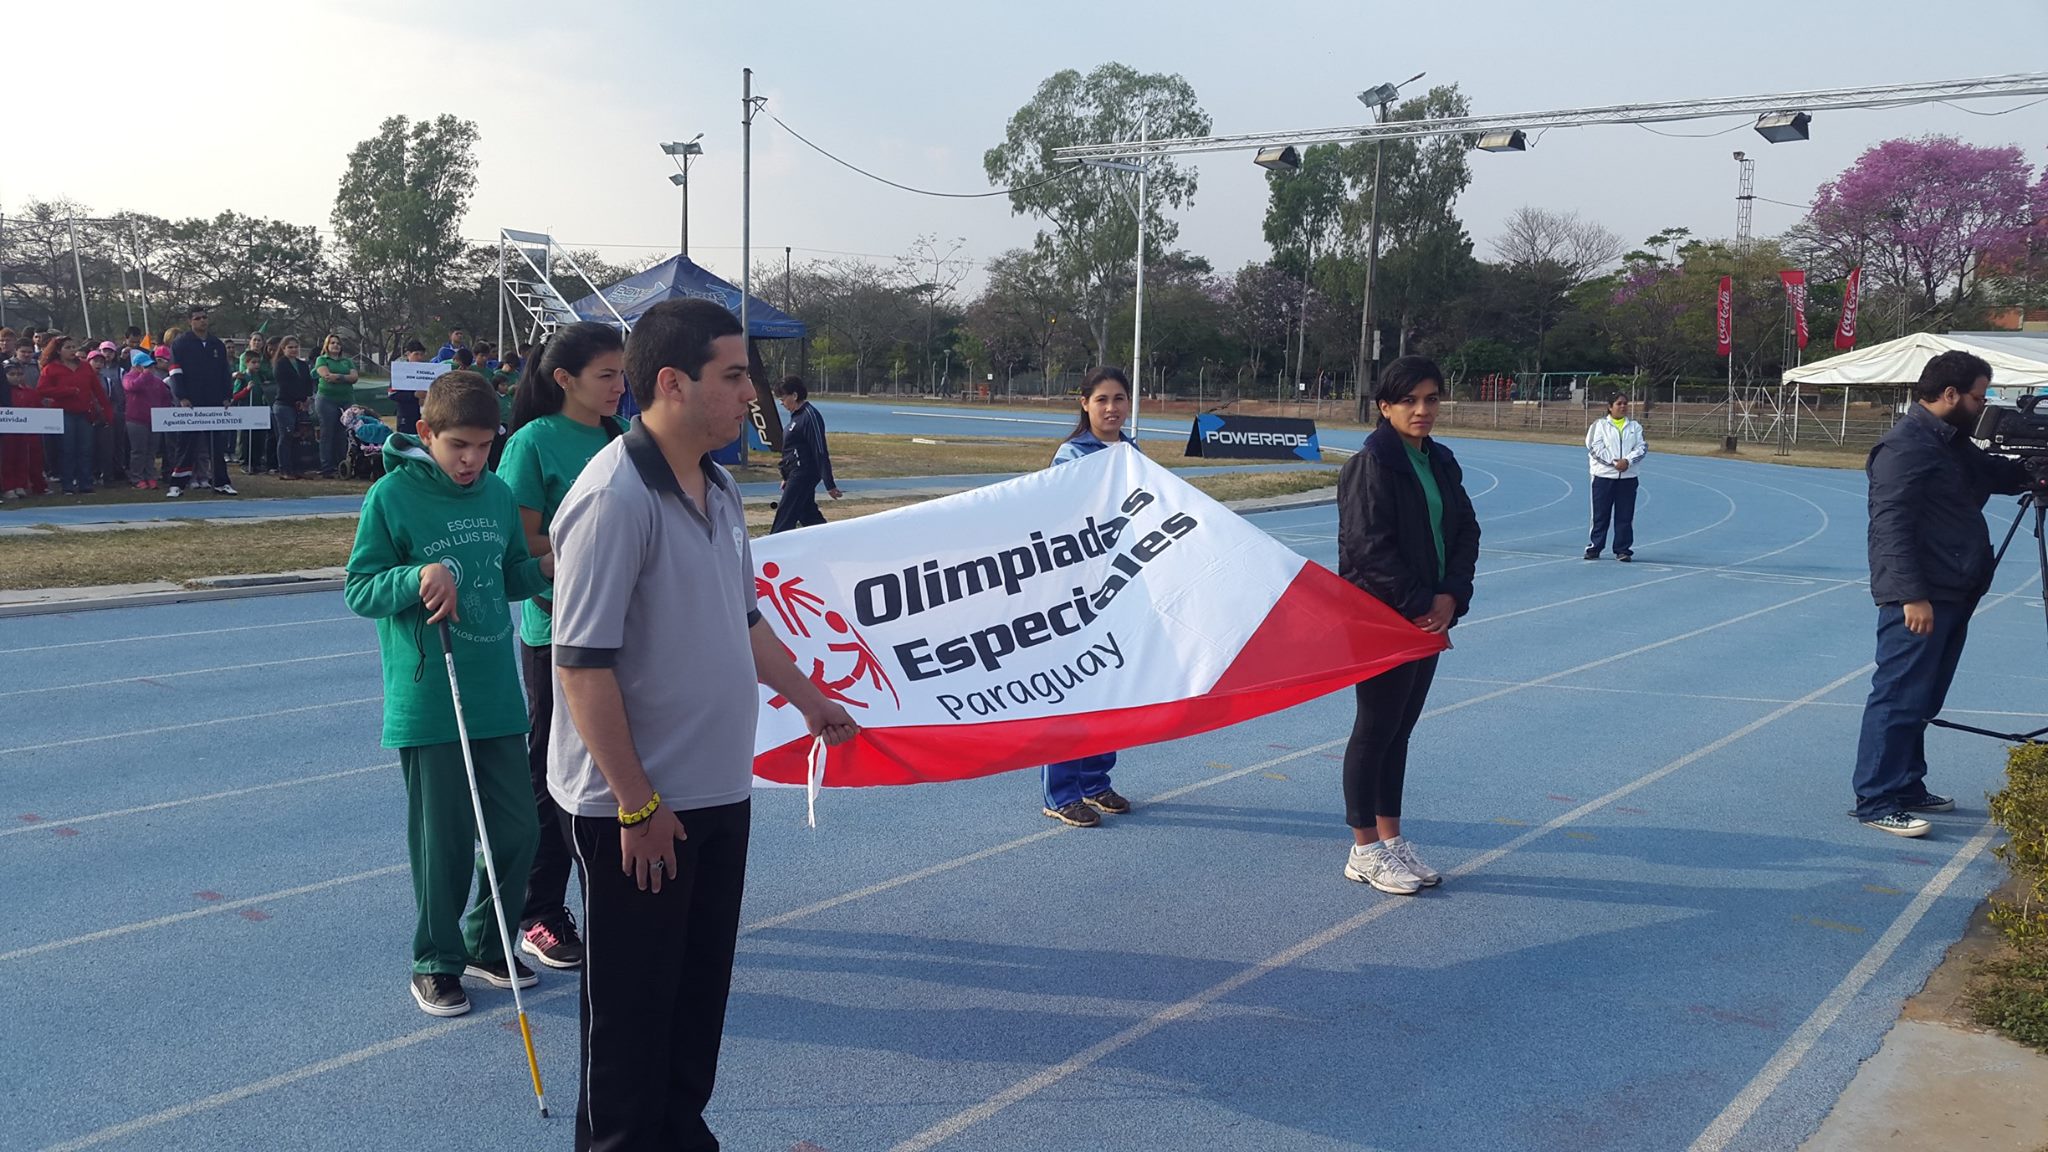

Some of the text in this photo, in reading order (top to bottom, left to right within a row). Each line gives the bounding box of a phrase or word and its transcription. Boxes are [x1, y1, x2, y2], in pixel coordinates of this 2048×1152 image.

[194, 410, 223, 418] Educativo
[1205, 430, 1309, 447] POWERADE
[447, 518, 499, 532] ESCUELA
[423, 537, 451, 557] DON
[453, 531, 480, 546] LUIS
[854, 488, 1155, 627] Olimpiadas
[892, 512, 1198, 682] Especiales
[457, 629, 473, 641] LOS
[936, 631, 1126, 721] Paraguay
